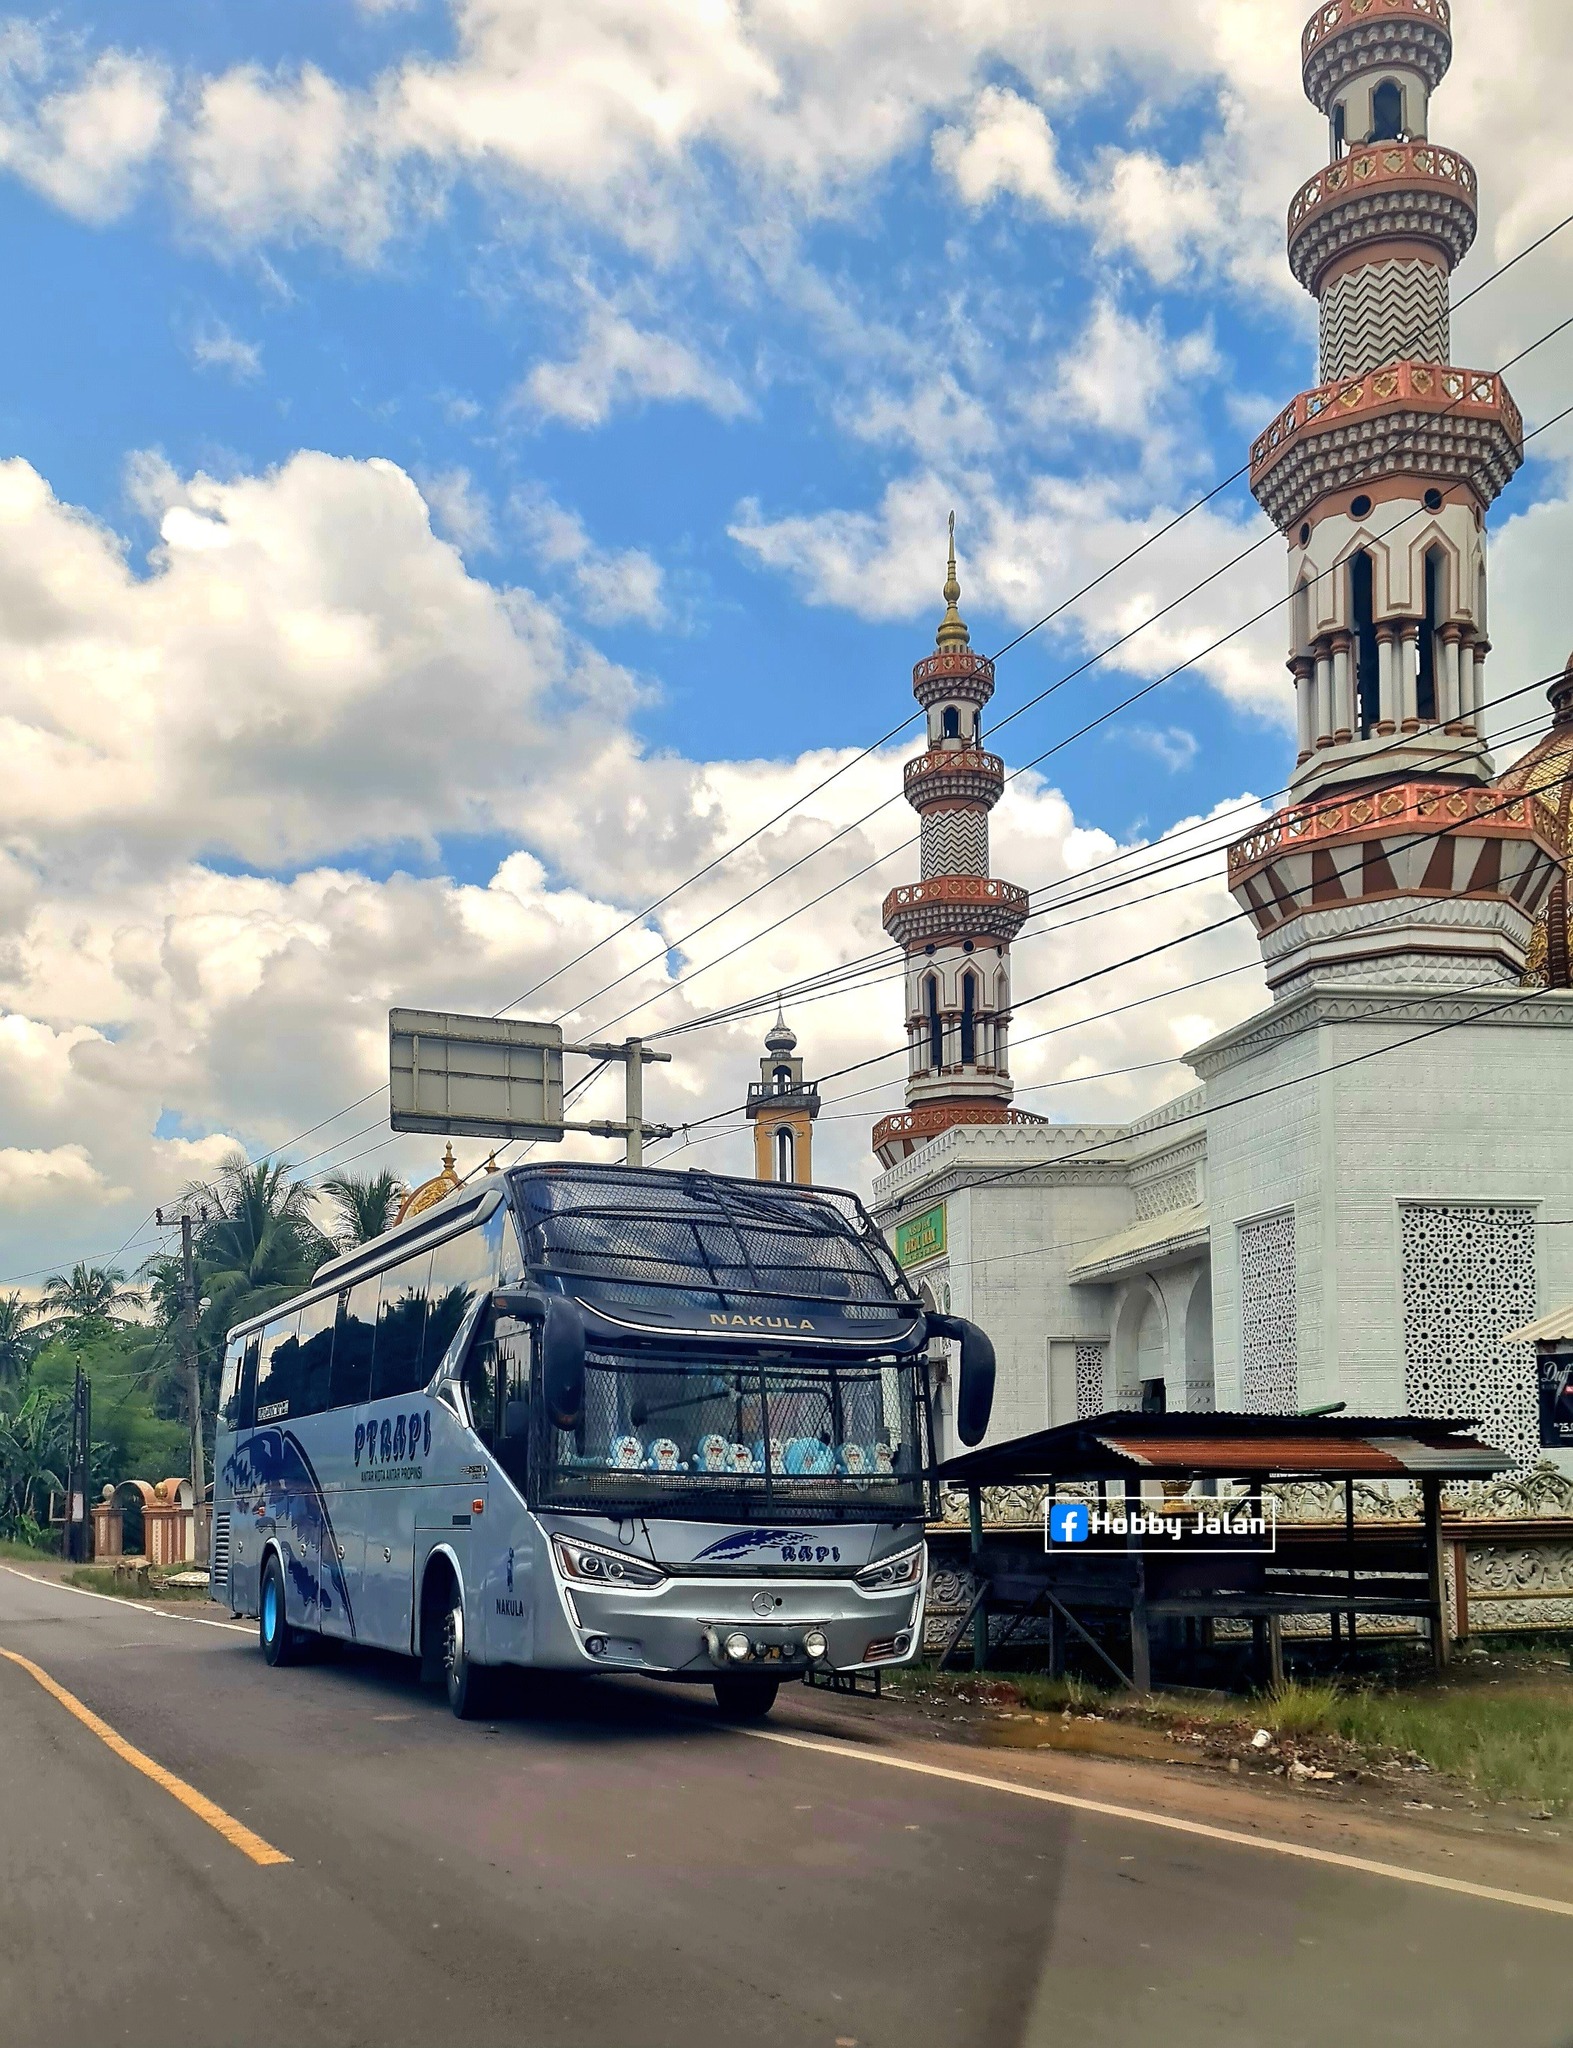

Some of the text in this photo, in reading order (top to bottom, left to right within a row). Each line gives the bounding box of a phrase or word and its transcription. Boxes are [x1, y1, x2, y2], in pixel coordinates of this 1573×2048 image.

[709, 1313, 816, 1331] NAKULA
[780, 1544, 841, 1563] RAPI
[496, 1598, 524, 1617] NAKULA
